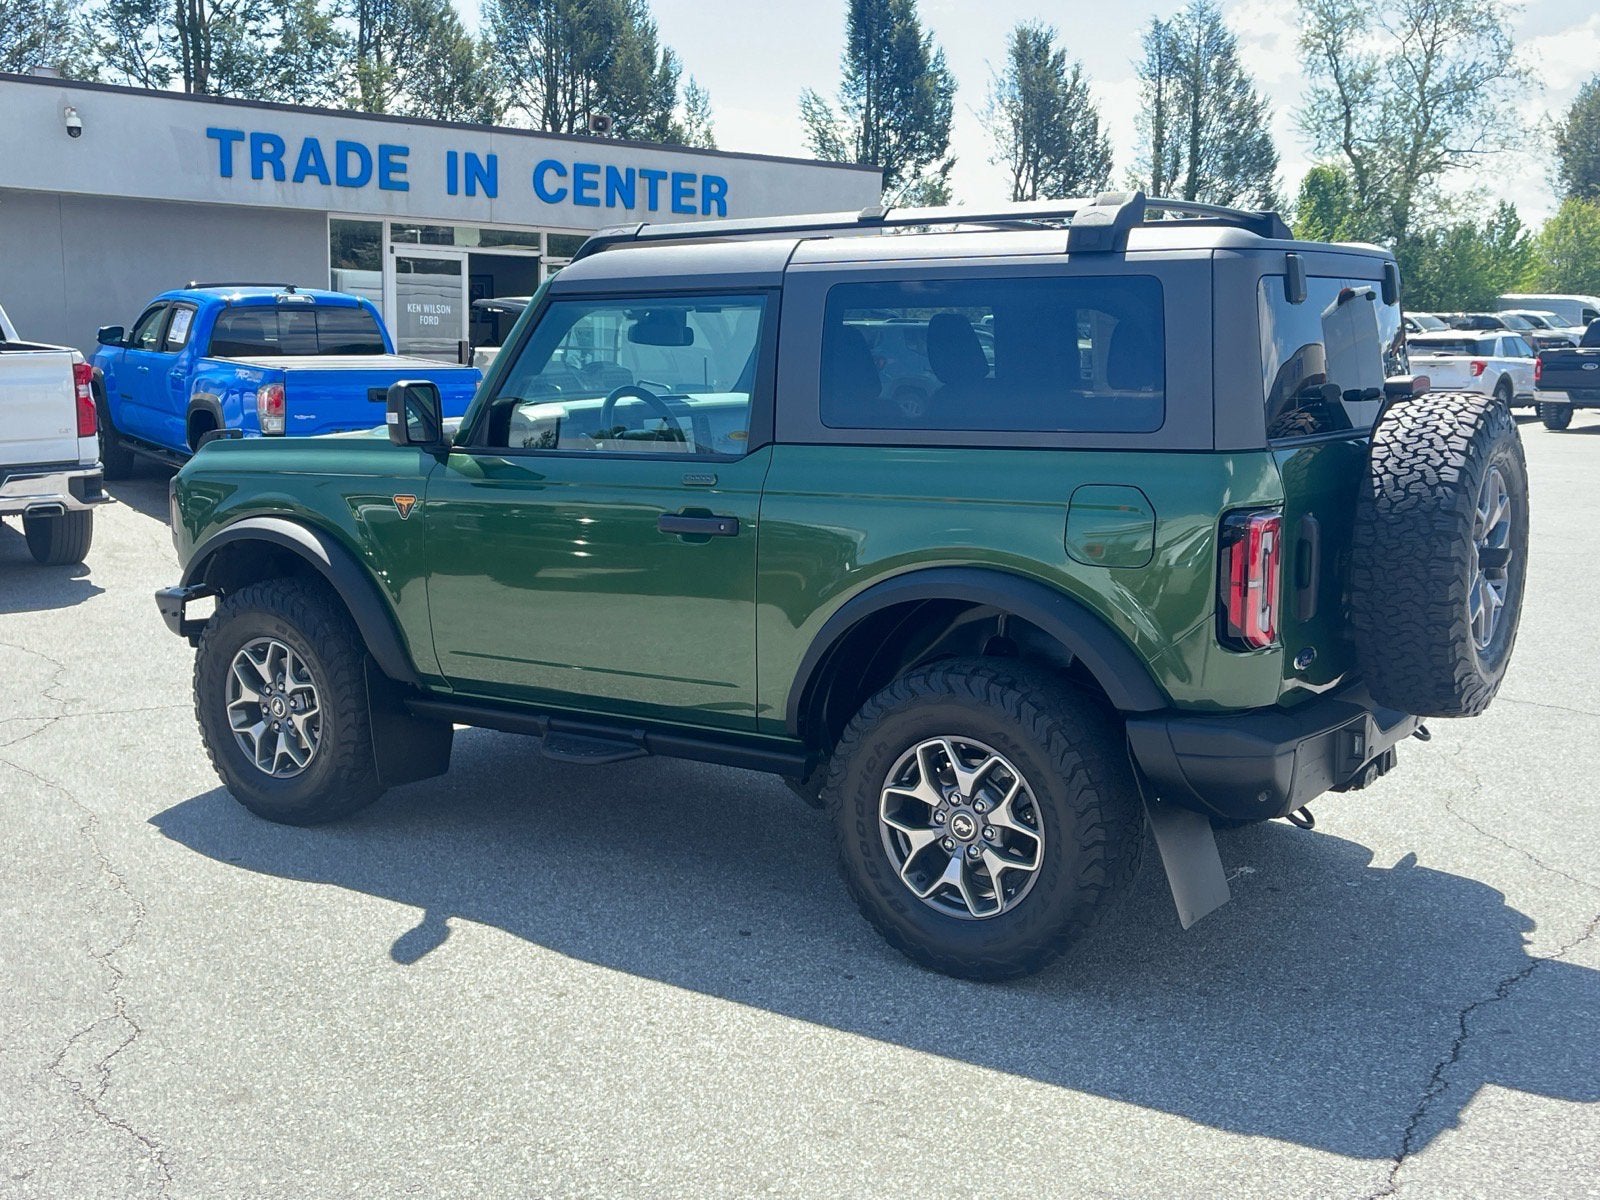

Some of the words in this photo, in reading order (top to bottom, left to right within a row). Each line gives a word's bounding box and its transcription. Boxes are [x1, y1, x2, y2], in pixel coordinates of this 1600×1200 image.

[206, 127, 410, 192] TRADE
[446, 150, 498, 198] IN
[532, 159, 728, 217] CENTER
[407, 303, 422, 313] KEN
[423, 304, 451, 314] WILSON
[419, 315, 439, 325] FORD
